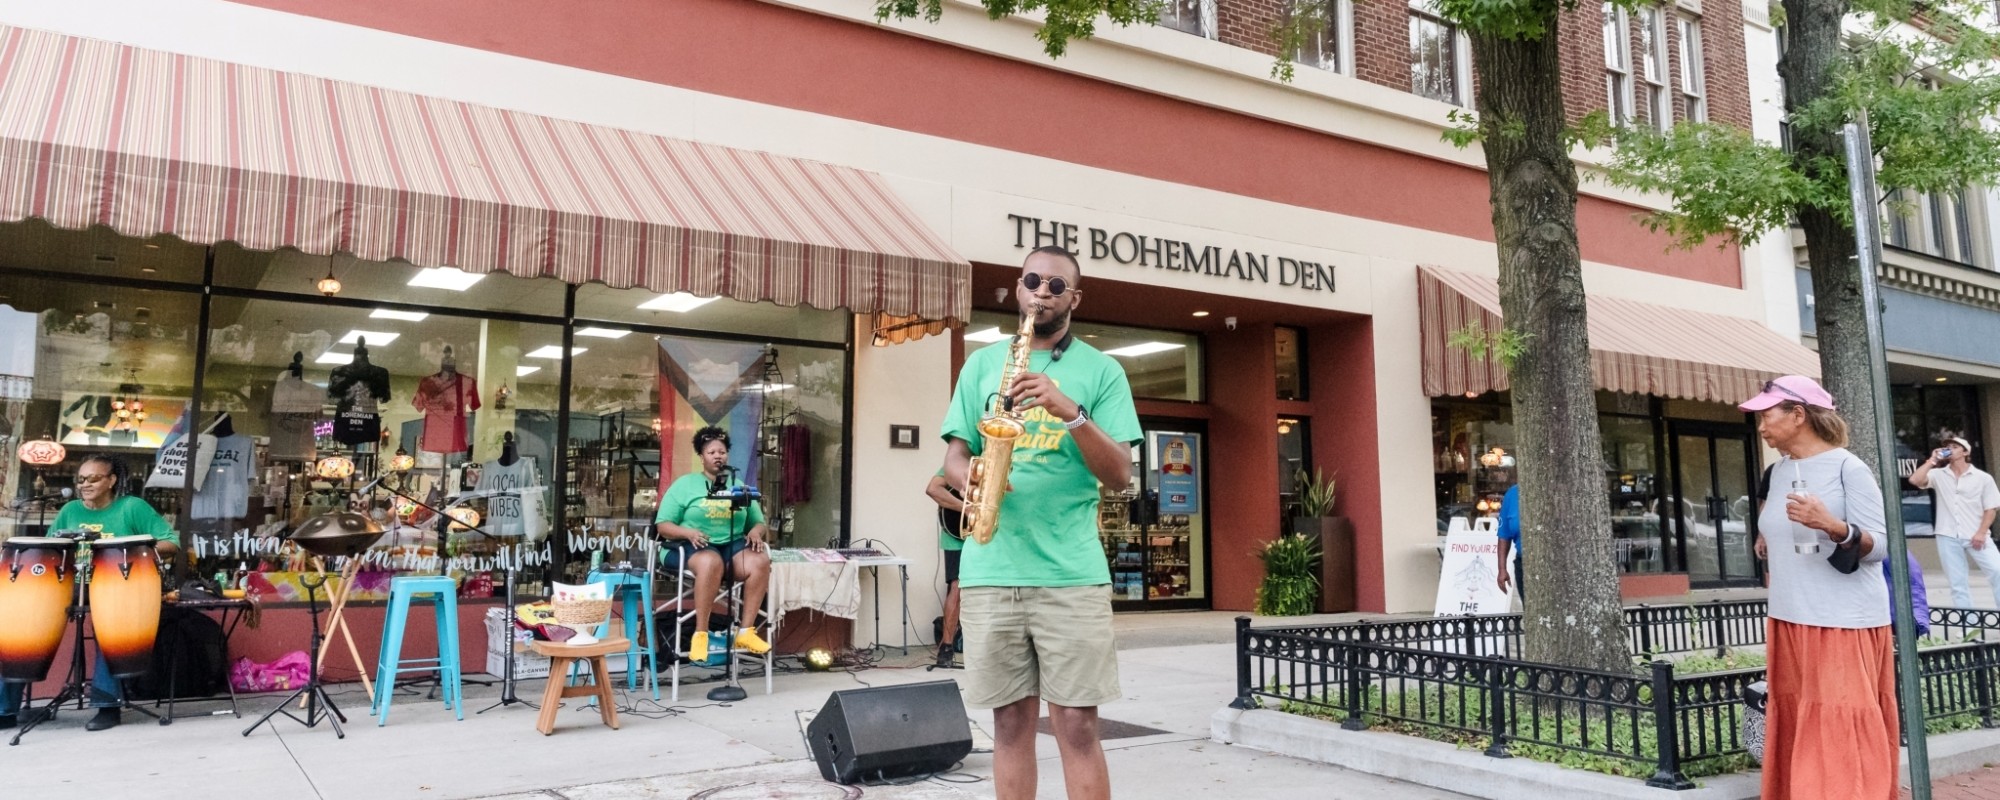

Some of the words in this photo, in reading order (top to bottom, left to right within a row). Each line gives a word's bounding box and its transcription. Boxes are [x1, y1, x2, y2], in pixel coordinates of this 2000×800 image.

[1008, 213, 1079, 257] THE
[1089, 227, 1269, 284] BOHEMIAN
[1278, 257, 1336, 293] DEN
[341, 412, 374, 420] BOHEMIAN
[1014, 424, 1067, 449] and
[162, 457, 187, 467] love
[213, 450, 239, 463] CAL
[489, 498, 520, 518] VIBES
[192, 533, 208, 559] It
[214, 535, 231, 556] is
[402, 547, 440, 574] that
[446, 556, 477, 577] you
[479, 545, 511, 572] will
[515, 541, 552, 571] find
[567, 524, 650, 553] Wonderl
[1451, 543, 1469, 553] FIND
[1470, 544, 1490, 553] YOUR
[1459, 601, 1479, 612] THE
